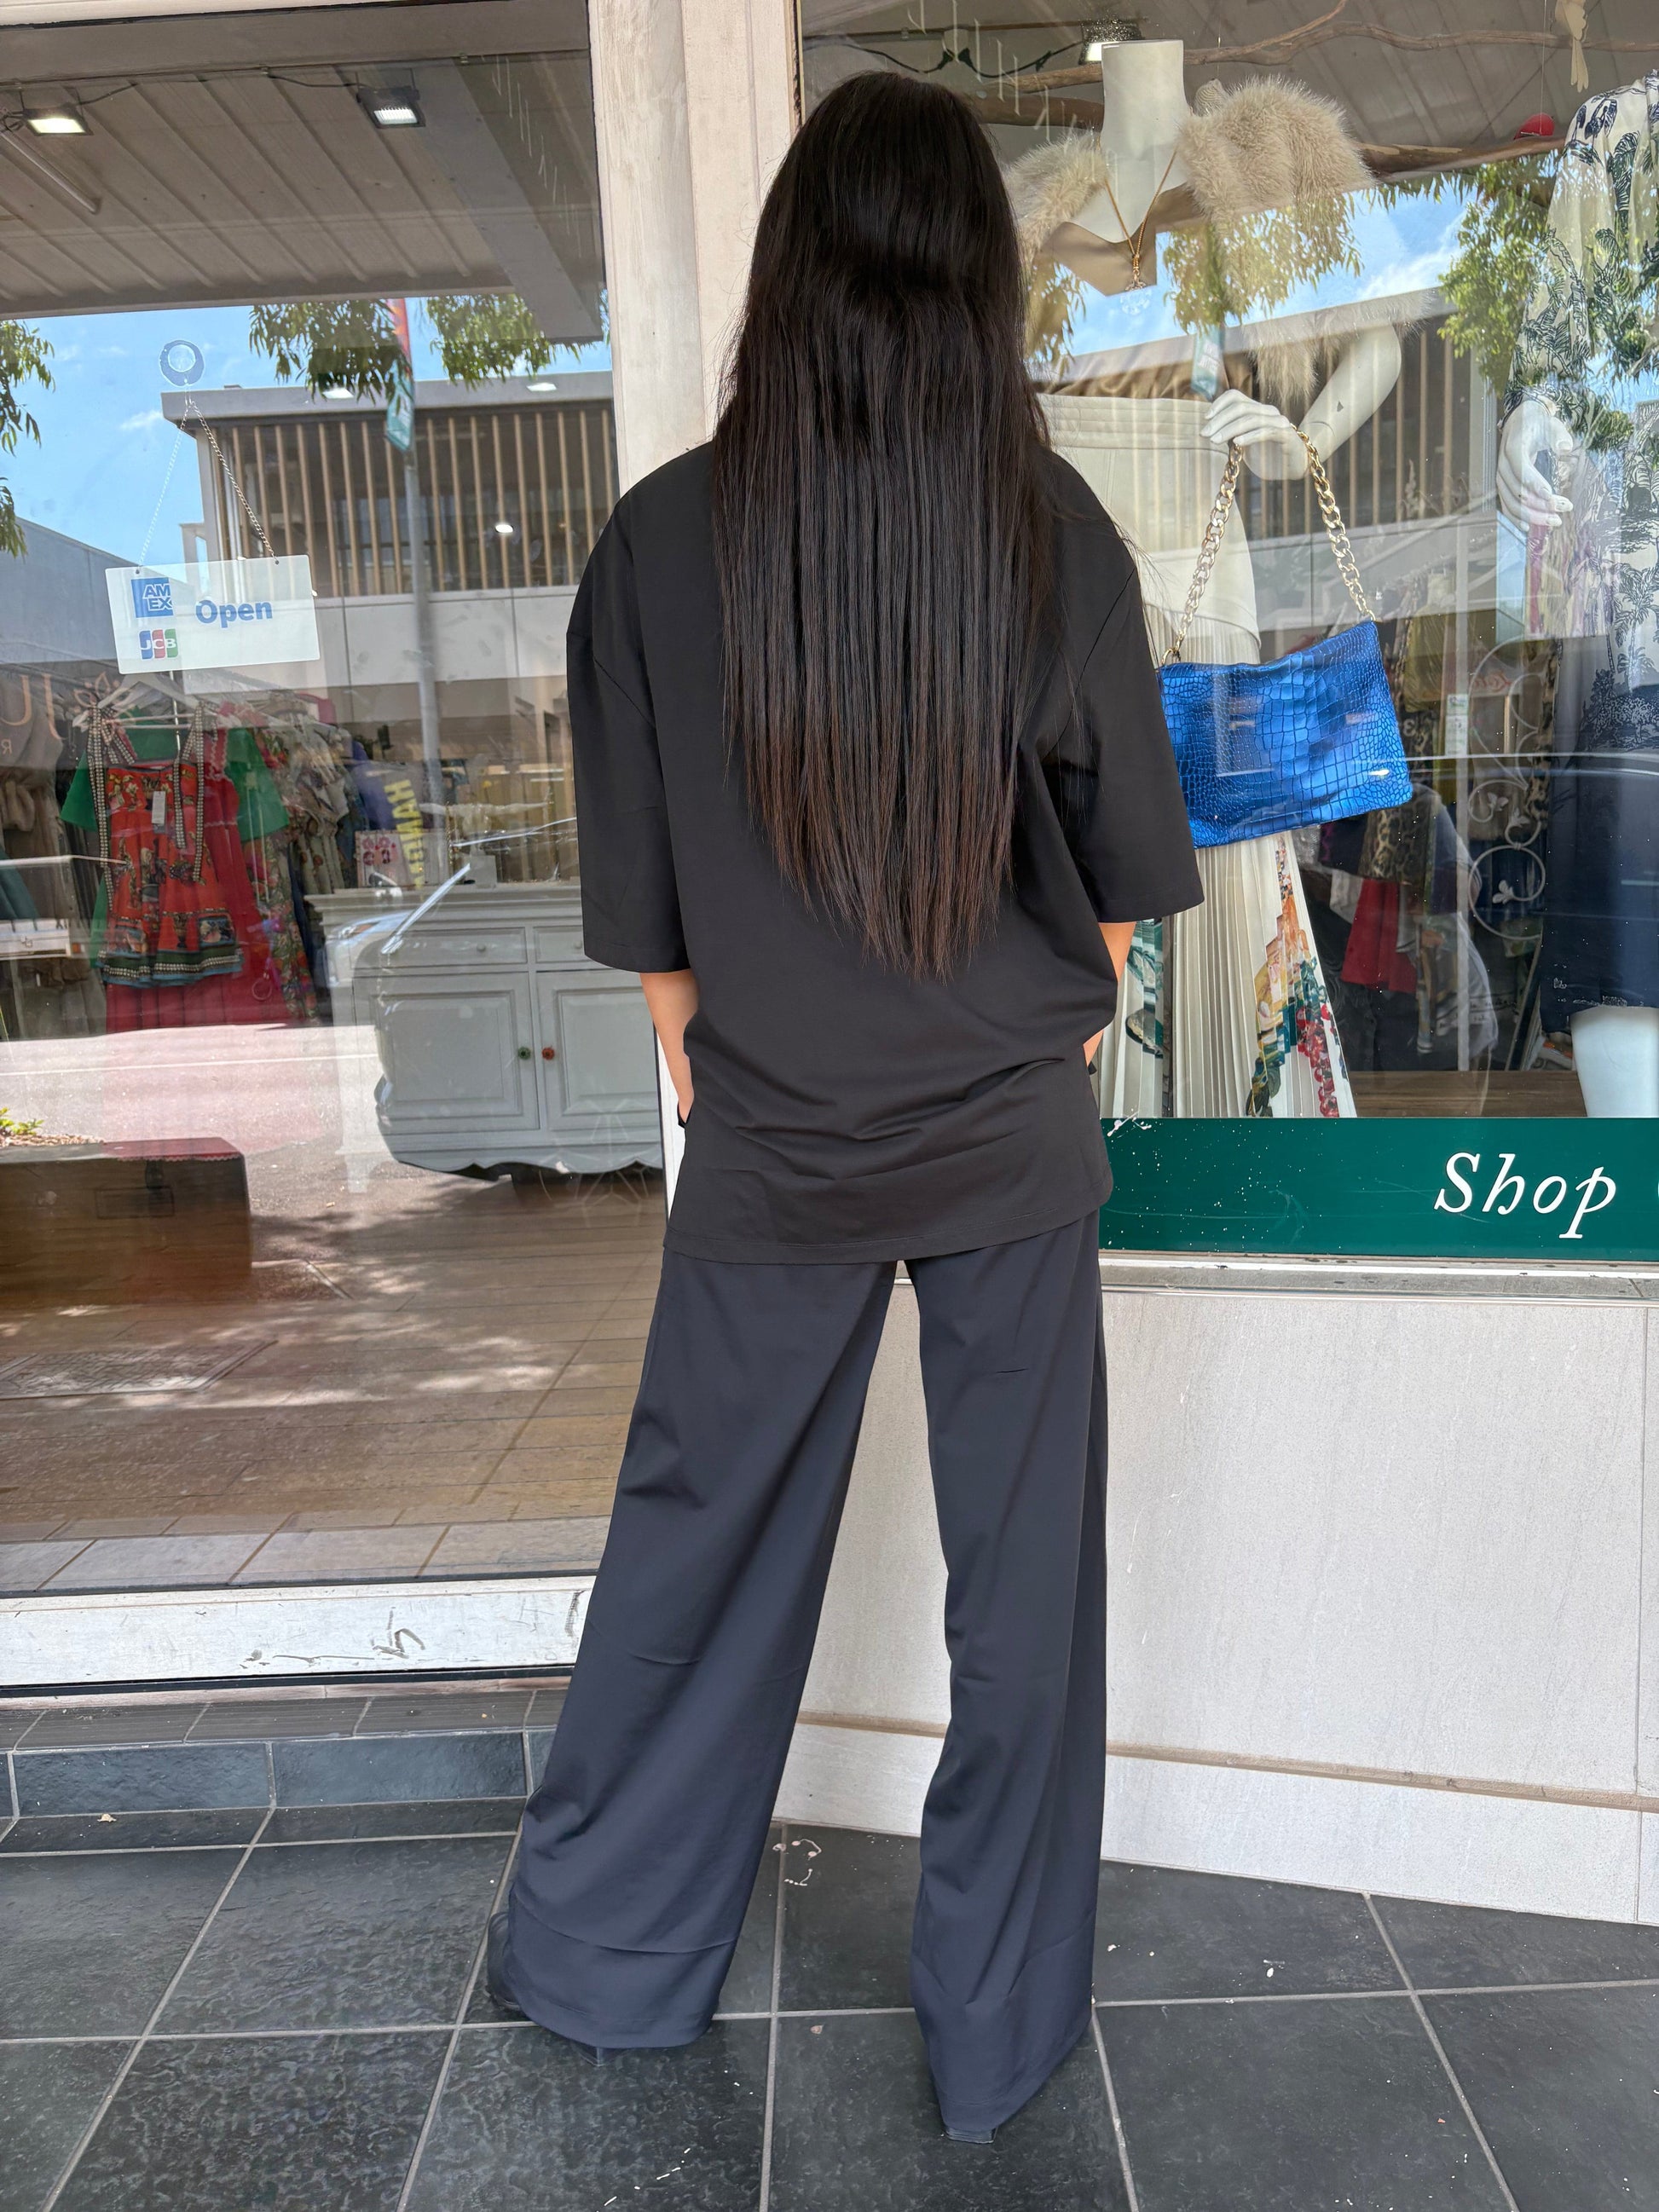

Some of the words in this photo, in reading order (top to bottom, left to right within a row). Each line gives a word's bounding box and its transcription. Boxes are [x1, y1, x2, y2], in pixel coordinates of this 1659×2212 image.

[143, 583, 171, 598] AM
[148, 598, 173, 610] EX
[195, 600, 273, 628] Open
[140, 639, 177, 650] JCB
[1434, 1152, 1616, 1239] Shop
